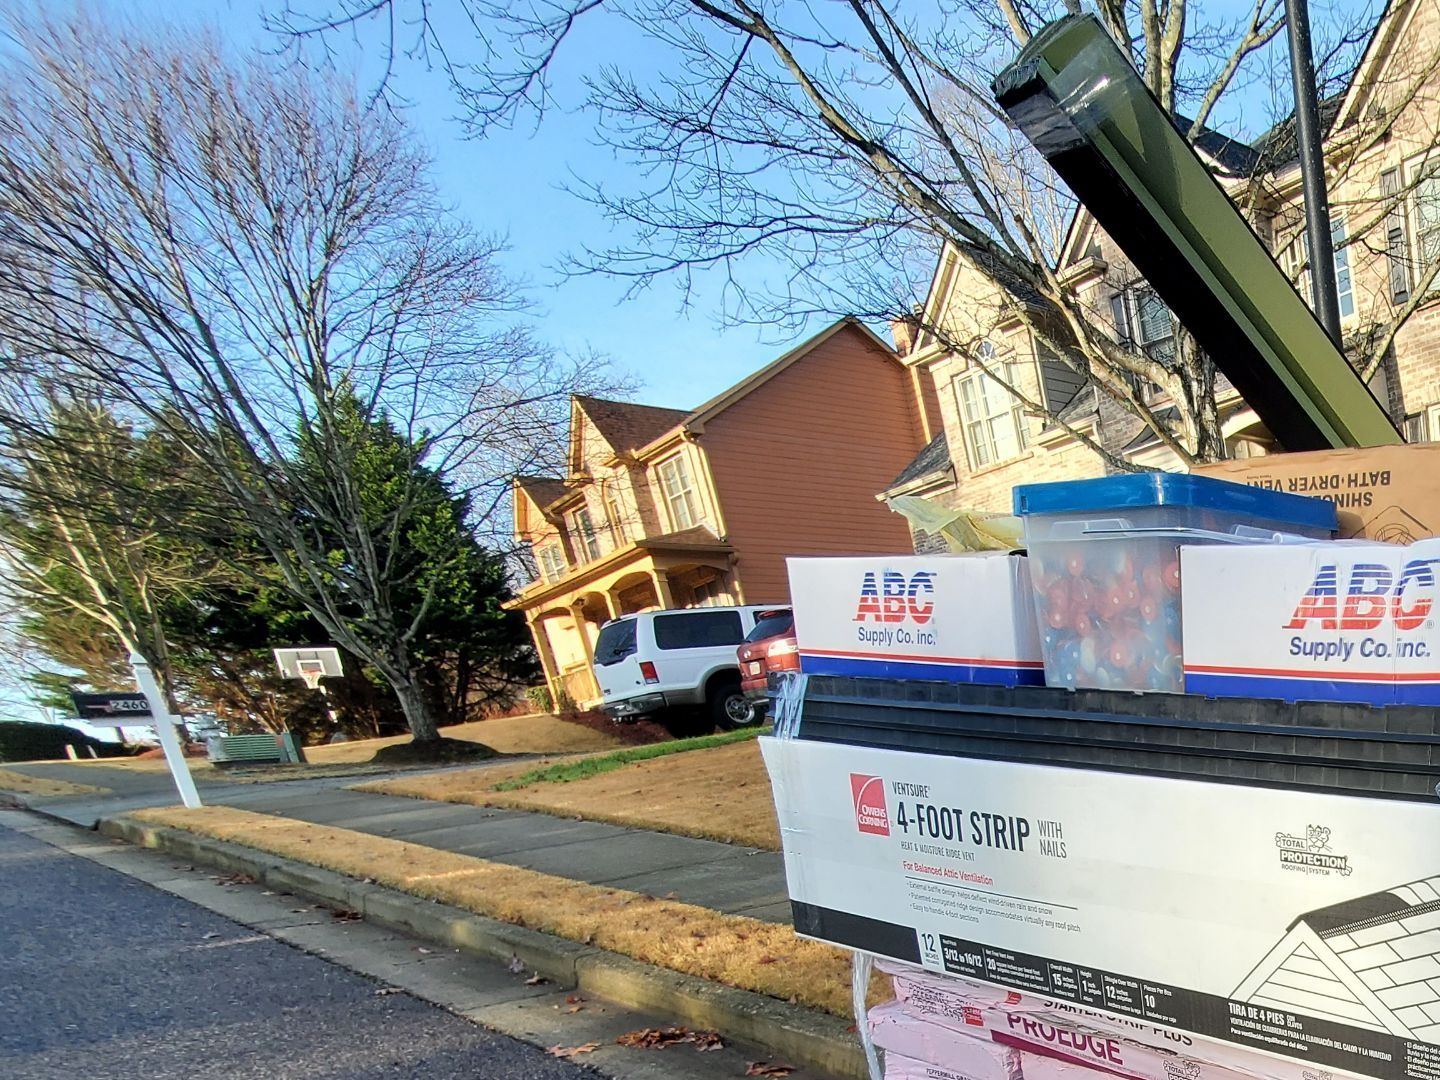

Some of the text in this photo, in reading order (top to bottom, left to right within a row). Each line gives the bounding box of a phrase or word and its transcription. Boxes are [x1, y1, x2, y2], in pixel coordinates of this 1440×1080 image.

[1288, 474, 1340, 491] DRYER
[1347, 470, 1391, 487] BATH
[852, 572, 938, 624] ABC
[858, 627, 937, 647] Supply Co. inc.
[1289, 636, 1431, 661] Supply Co. inc.
[861, 804, 887, 818] OWENS
[858, 816, 888, 829] CORNING
[897, 801, 1030, 852] 4-FOOT STRIP
[1037, 819, 1063, 839] WITH
[1039, 839, 1067, 859] NAILS
[1281, 838, 1305, 848] TOTAL
[1280, 850, 1346, 869] PROTECTION
[903, 861, 993, 885] For Balanced Attic Ventilation
[921, 934, 936, 952] 12
[944, 947, 959, 961] 3/12
[964, 952, 983, 968] 16/12
[986, 957, 997, 970] 20
[1052, 973, 1062, 986] 15
[1105, 985, 1116, 999] 12
[1144, 995, 1155, 1008] 10
[1228, 1002, 1285, 1026] TIRA DE 4 PIES
[1007, 1013, 1123, 1066] PROEDGE
